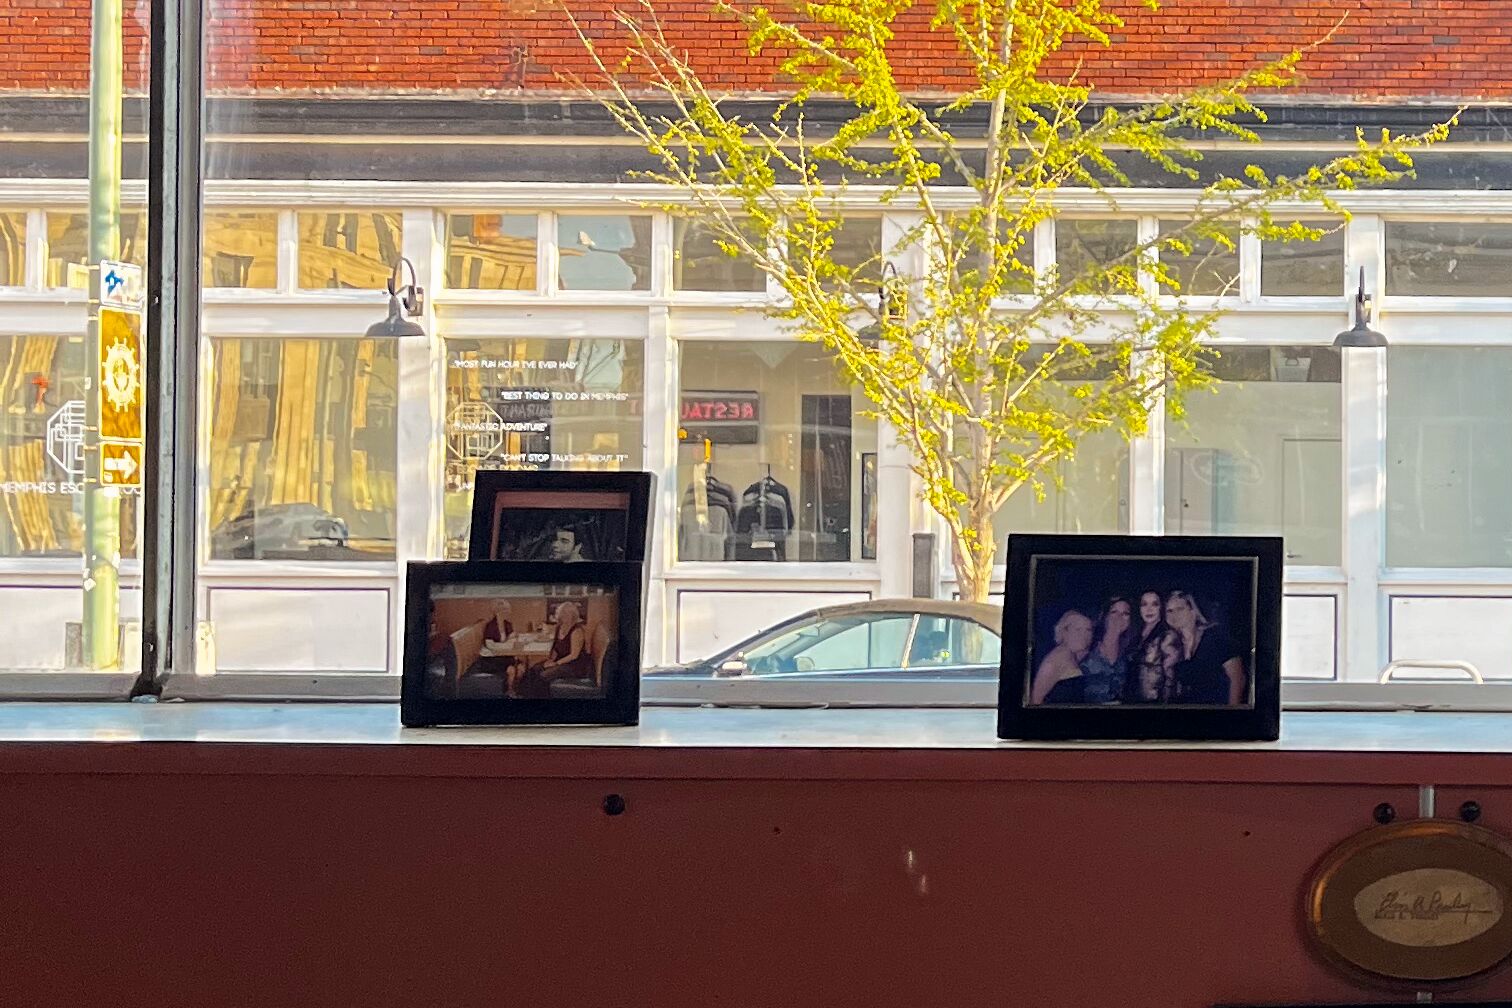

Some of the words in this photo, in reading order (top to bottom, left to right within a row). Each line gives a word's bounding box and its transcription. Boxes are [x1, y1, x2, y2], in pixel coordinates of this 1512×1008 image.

[551, 392, 562, 400] TO
[565, 392, 578, 400] DO
[528, 454, 550, 462] STOP
